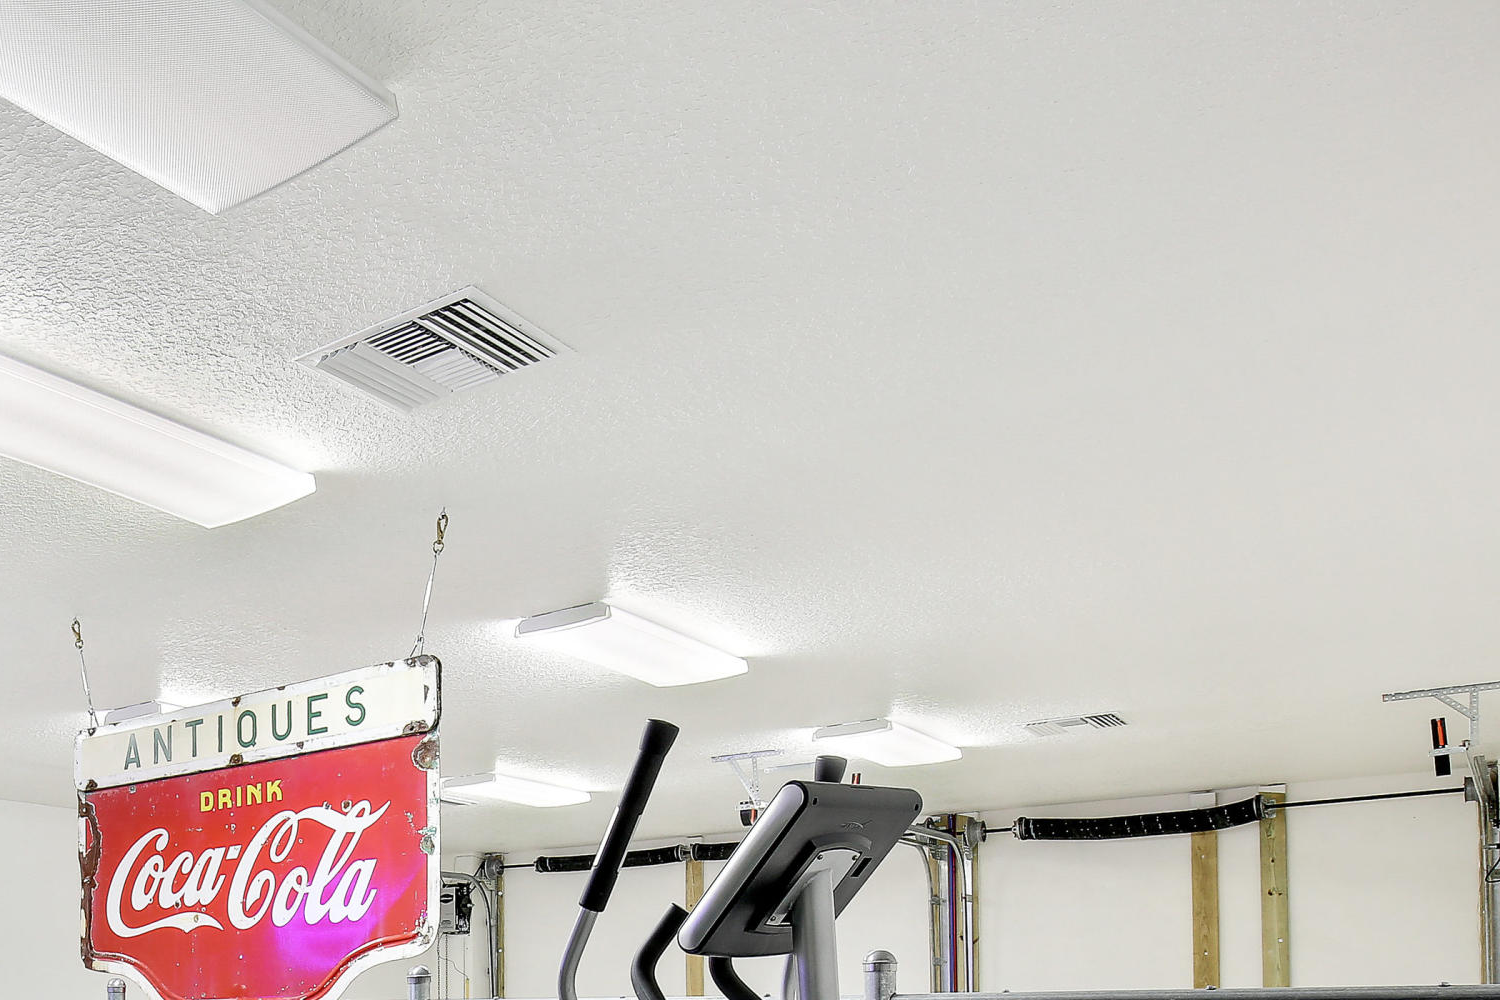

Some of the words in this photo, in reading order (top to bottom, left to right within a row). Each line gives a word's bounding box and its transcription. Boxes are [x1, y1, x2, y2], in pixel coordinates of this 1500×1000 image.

[124, 685, 367, 770] ANTIQUES
[200, 779, 283, 812] DRINK
[106, 799, 390, 938] Coca-Cola
